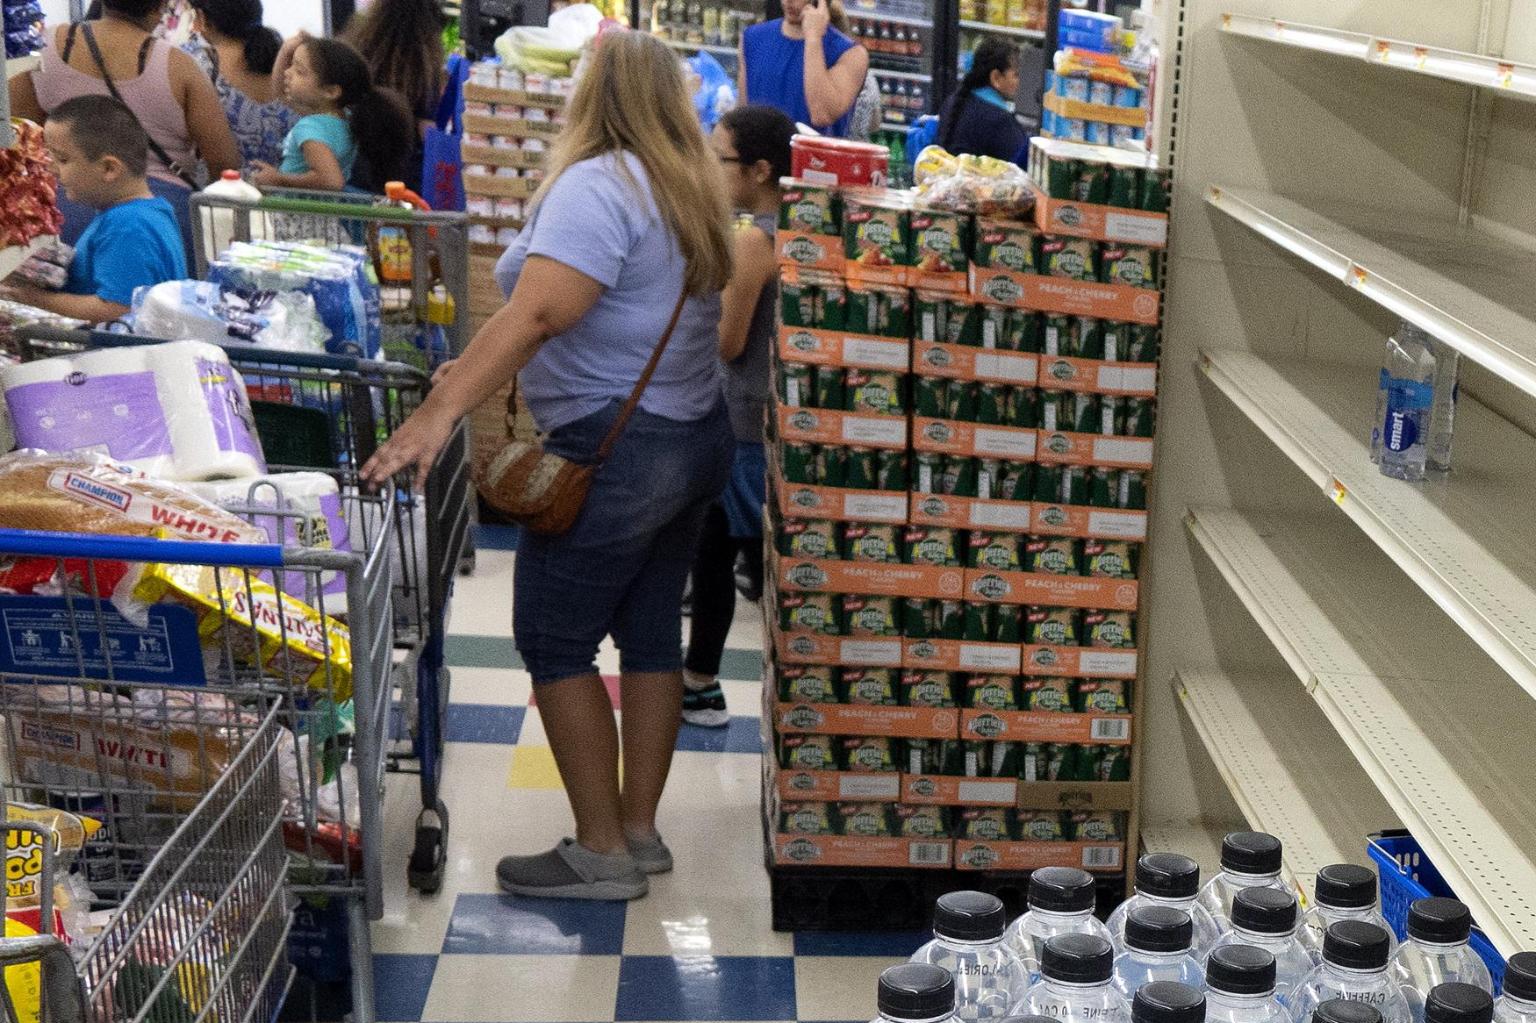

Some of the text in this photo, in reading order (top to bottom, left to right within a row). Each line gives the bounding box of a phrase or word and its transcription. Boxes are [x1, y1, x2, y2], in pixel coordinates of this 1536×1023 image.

[1390, 411, 1405, 451] smart
[70, 477, 124, 506] CHAMPION
[151, 505, 241, 542] WHITE
